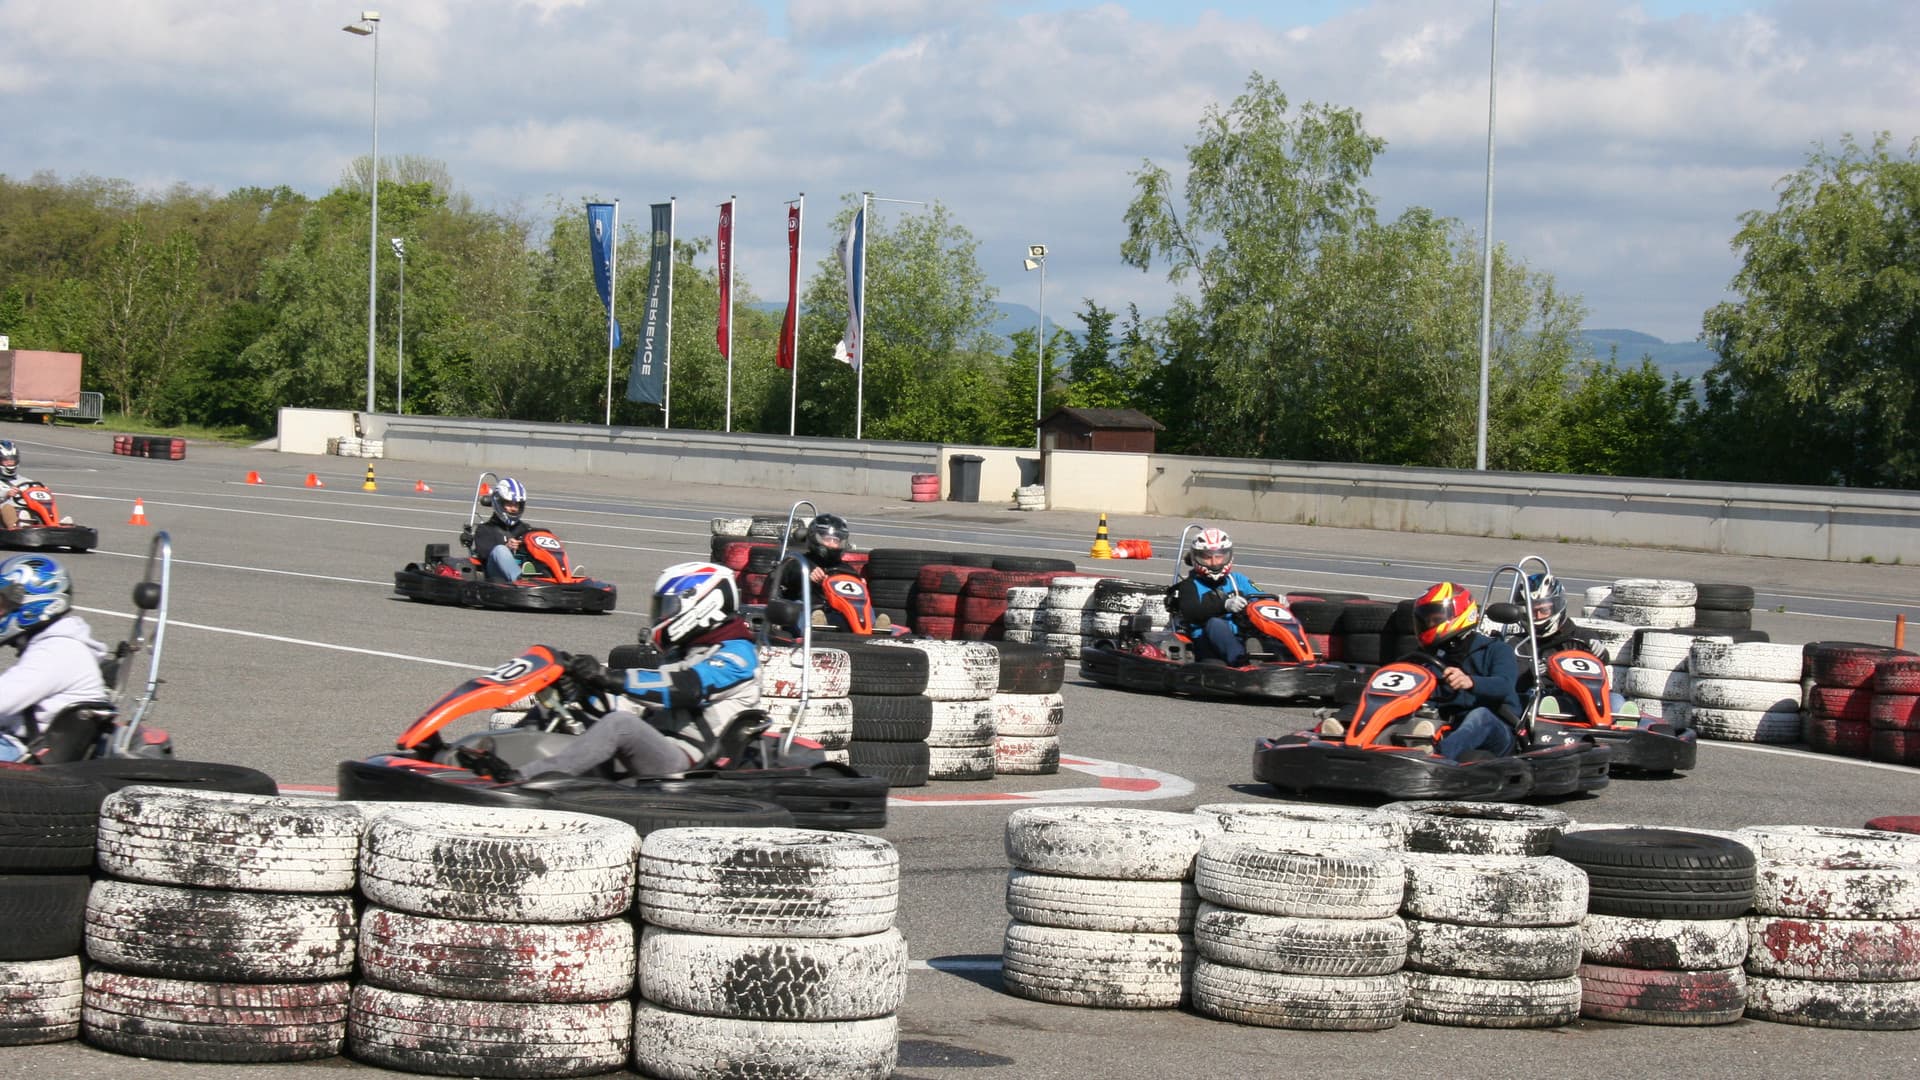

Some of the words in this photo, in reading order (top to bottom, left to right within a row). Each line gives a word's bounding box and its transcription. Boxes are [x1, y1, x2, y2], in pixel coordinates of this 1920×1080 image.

[538, 537, 558, 546] 24
[842, 583, 854, 592] 4
[1267, 607, 1280, 617] 7
[489, 660, 527, 679] 20
[1572, 660, 1590, 671] 9
[1382, 674, 1404, 687] 3
